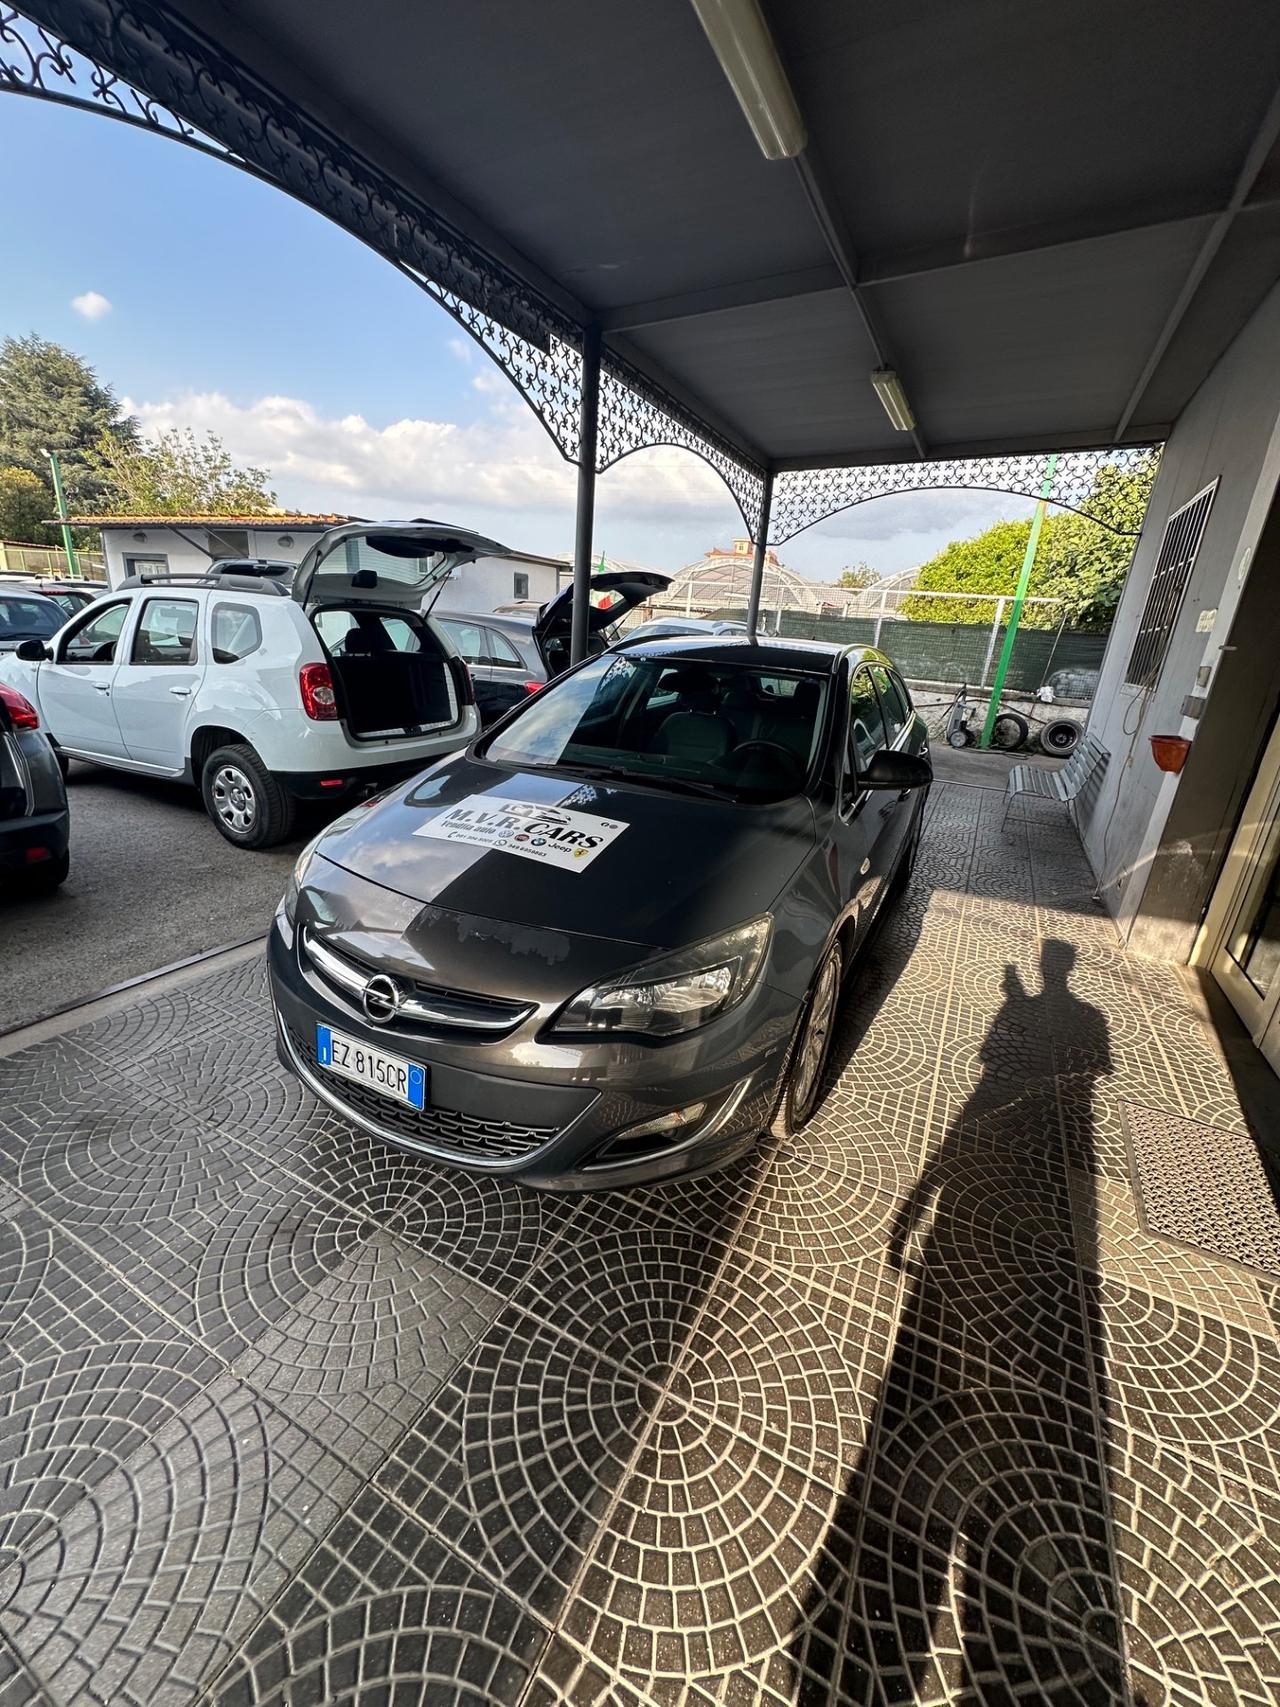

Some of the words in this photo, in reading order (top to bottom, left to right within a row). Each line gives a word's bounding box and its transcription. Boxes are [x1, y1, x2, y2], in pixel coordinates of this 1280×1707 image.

[445, 809, 521, 830] M.V.R.
[524, 822, 604, 849] CARS
[548, 843, 572, 853] Jeep
[332, 1040, 350, 1068] EZ
[356, 1051, 407, 1095] 815CR
